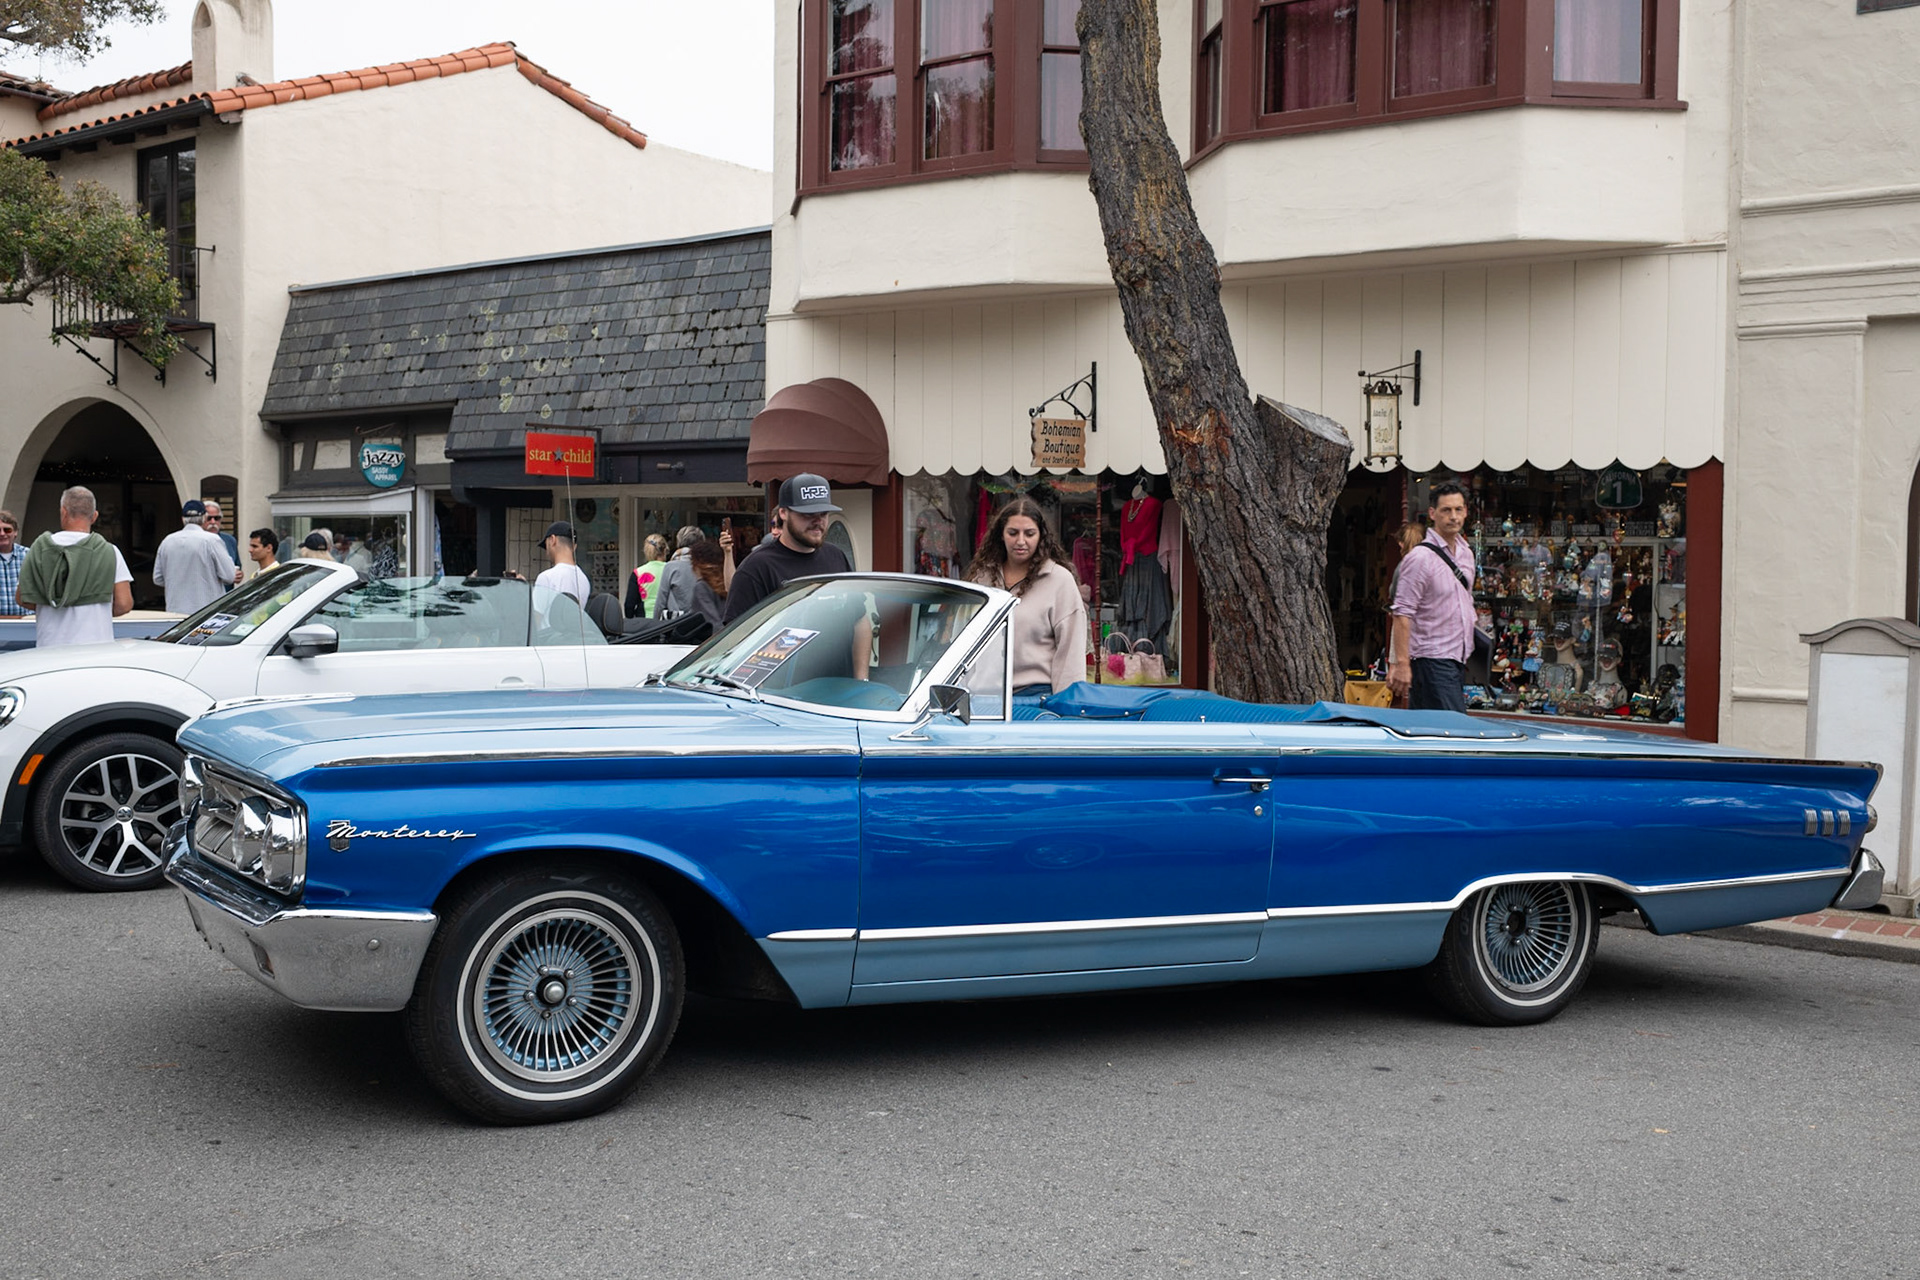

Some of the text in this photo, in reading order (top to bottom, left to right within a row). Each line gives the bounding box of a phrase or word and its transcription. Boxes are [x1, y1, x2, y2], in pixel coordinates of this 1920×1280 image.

[1040, 420, 1081, 437] Bohemian
[529, 448, 591, 463] star child
[1042, 438, 1080, 456] Boutique
[362, 449, 405, 468] jazzy
[1601, 471, 1636, 486] CALIFORNIA
[1613, 481, 1622, 503] 1
[325, 822, 477, 841] Monterey
